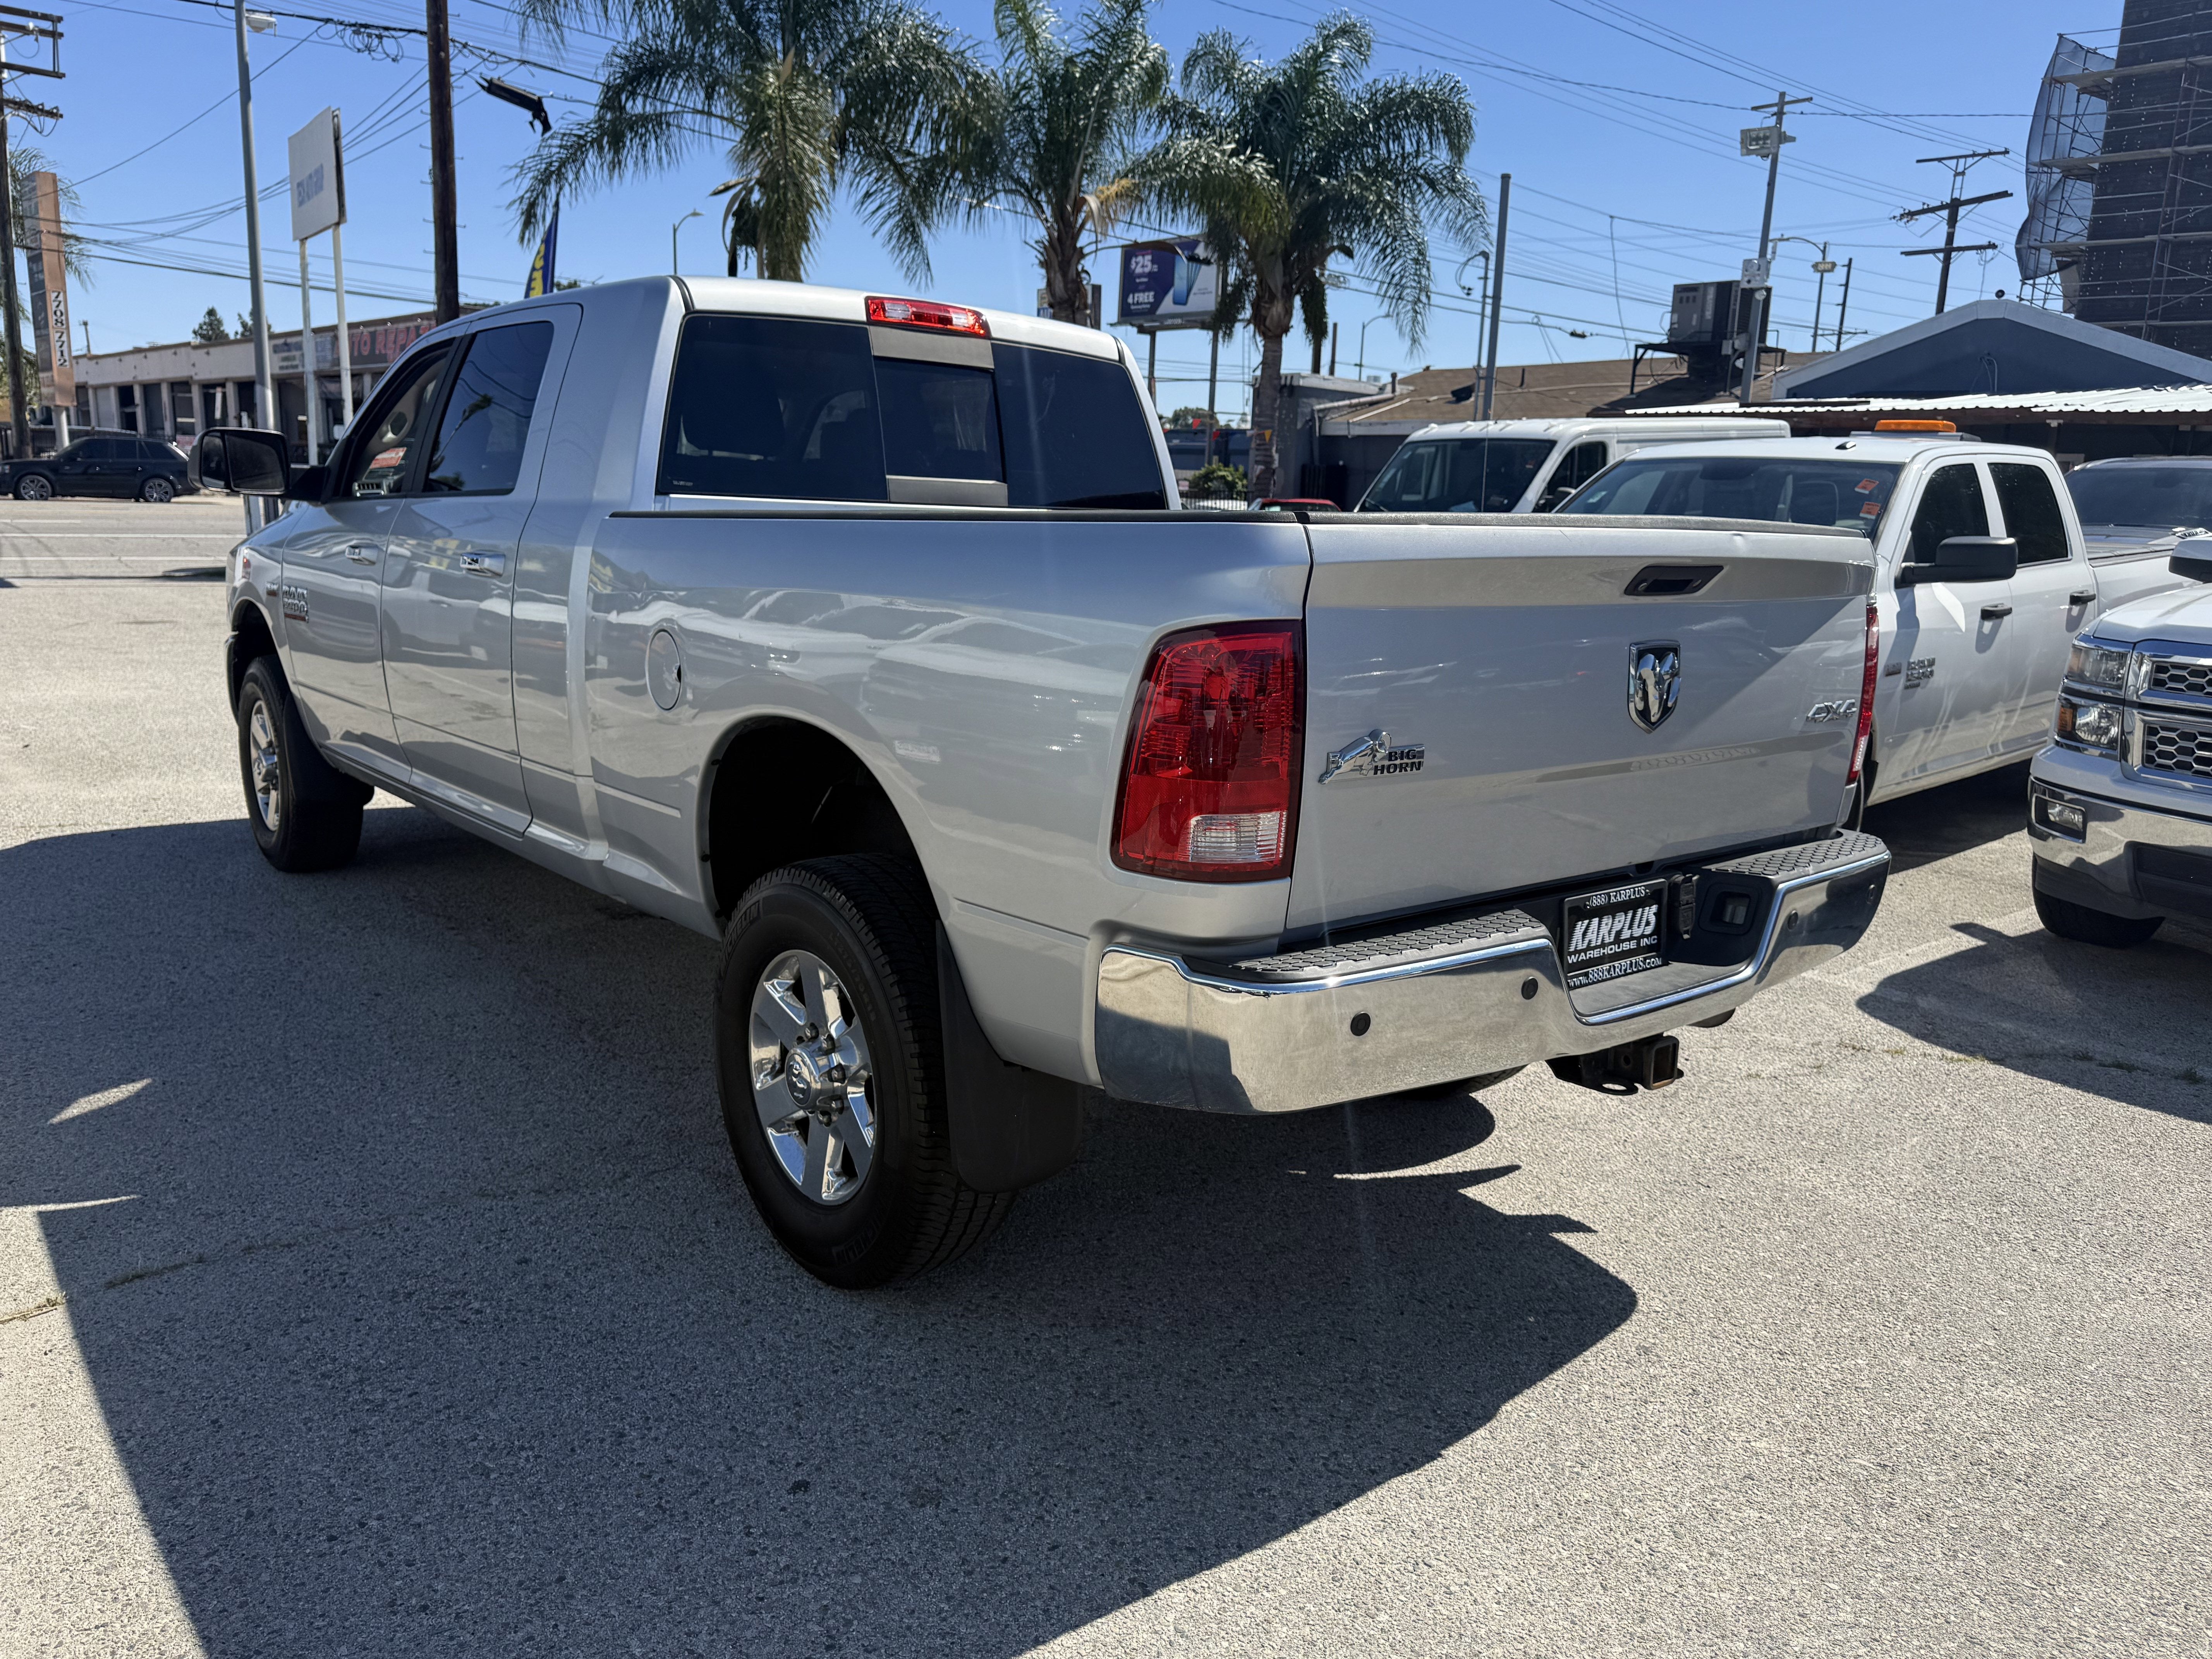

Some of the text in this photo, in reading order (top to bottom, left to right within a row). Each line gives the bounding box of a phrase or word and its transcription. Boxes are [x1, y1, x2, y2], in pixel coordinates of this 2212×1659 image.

[1130, 254, 1152, 274] $25
[1127, 291, 1155, 304] 4 FREE
[52, 291, 64, 327] 7708
[55, 330, 67, 367] 7712
[282, 585, 307, 599] RAM
[1388, 749, 1417, 762] BIG
[1373, 761, 1422, 775] HORN
[1590, 886, 1645, 907] (888) KARPLUS
[1568, 904, 1658, 951] KARPLUS
[1567, 936, 1657, 963] WAREHOUSE INC
